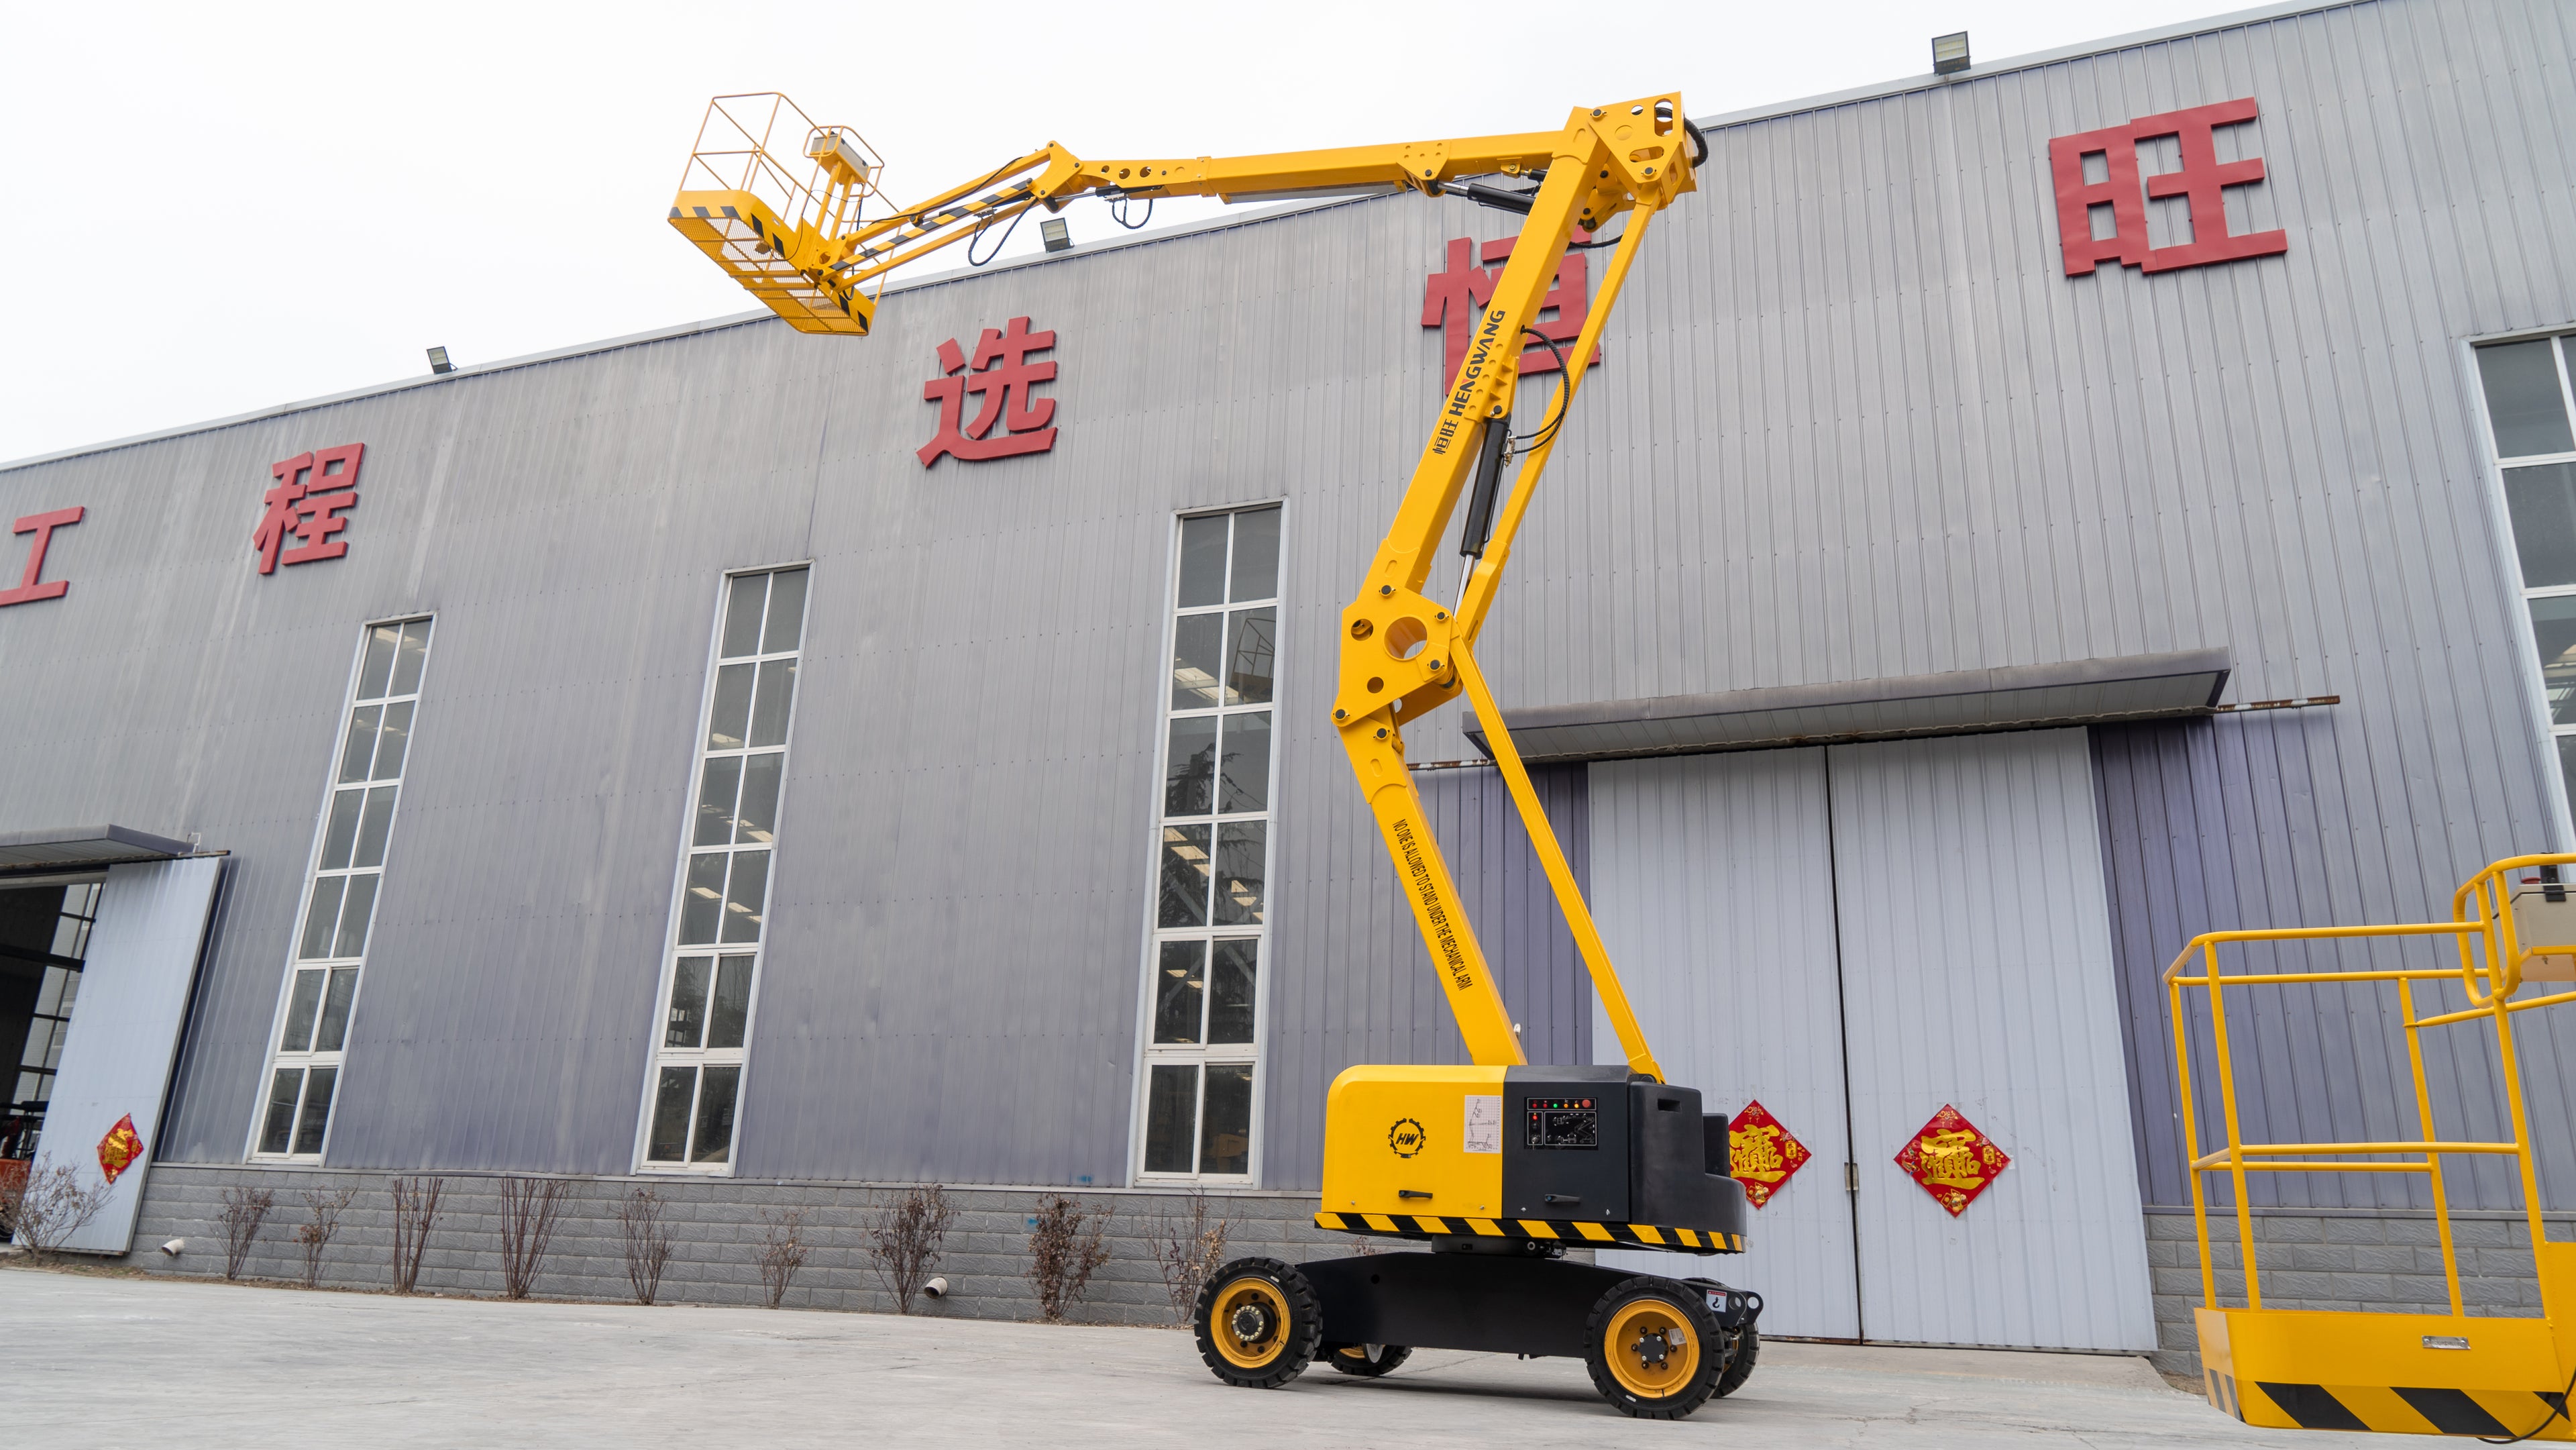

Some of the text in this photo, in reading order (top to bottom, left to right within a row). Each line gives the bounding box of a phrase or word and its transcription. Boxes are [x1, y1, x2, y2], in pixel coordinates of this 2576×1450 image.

[0, 506, 85, 605] 工
[253, 442, 365, 574] 程
[916, 316, 1058, 468] 选
[2049, 97, 2288, 277] 旺
[1448, 311, 1505, 417] HENGWANG
[1432, 419, 1458, 455] 恒旺
[1392, 819, 1472, 991] NO ONE IS ALLOWED TO STAND UNDER THE MECHANICAL ARM
[1395, 1133, 1419, 1145] HW
